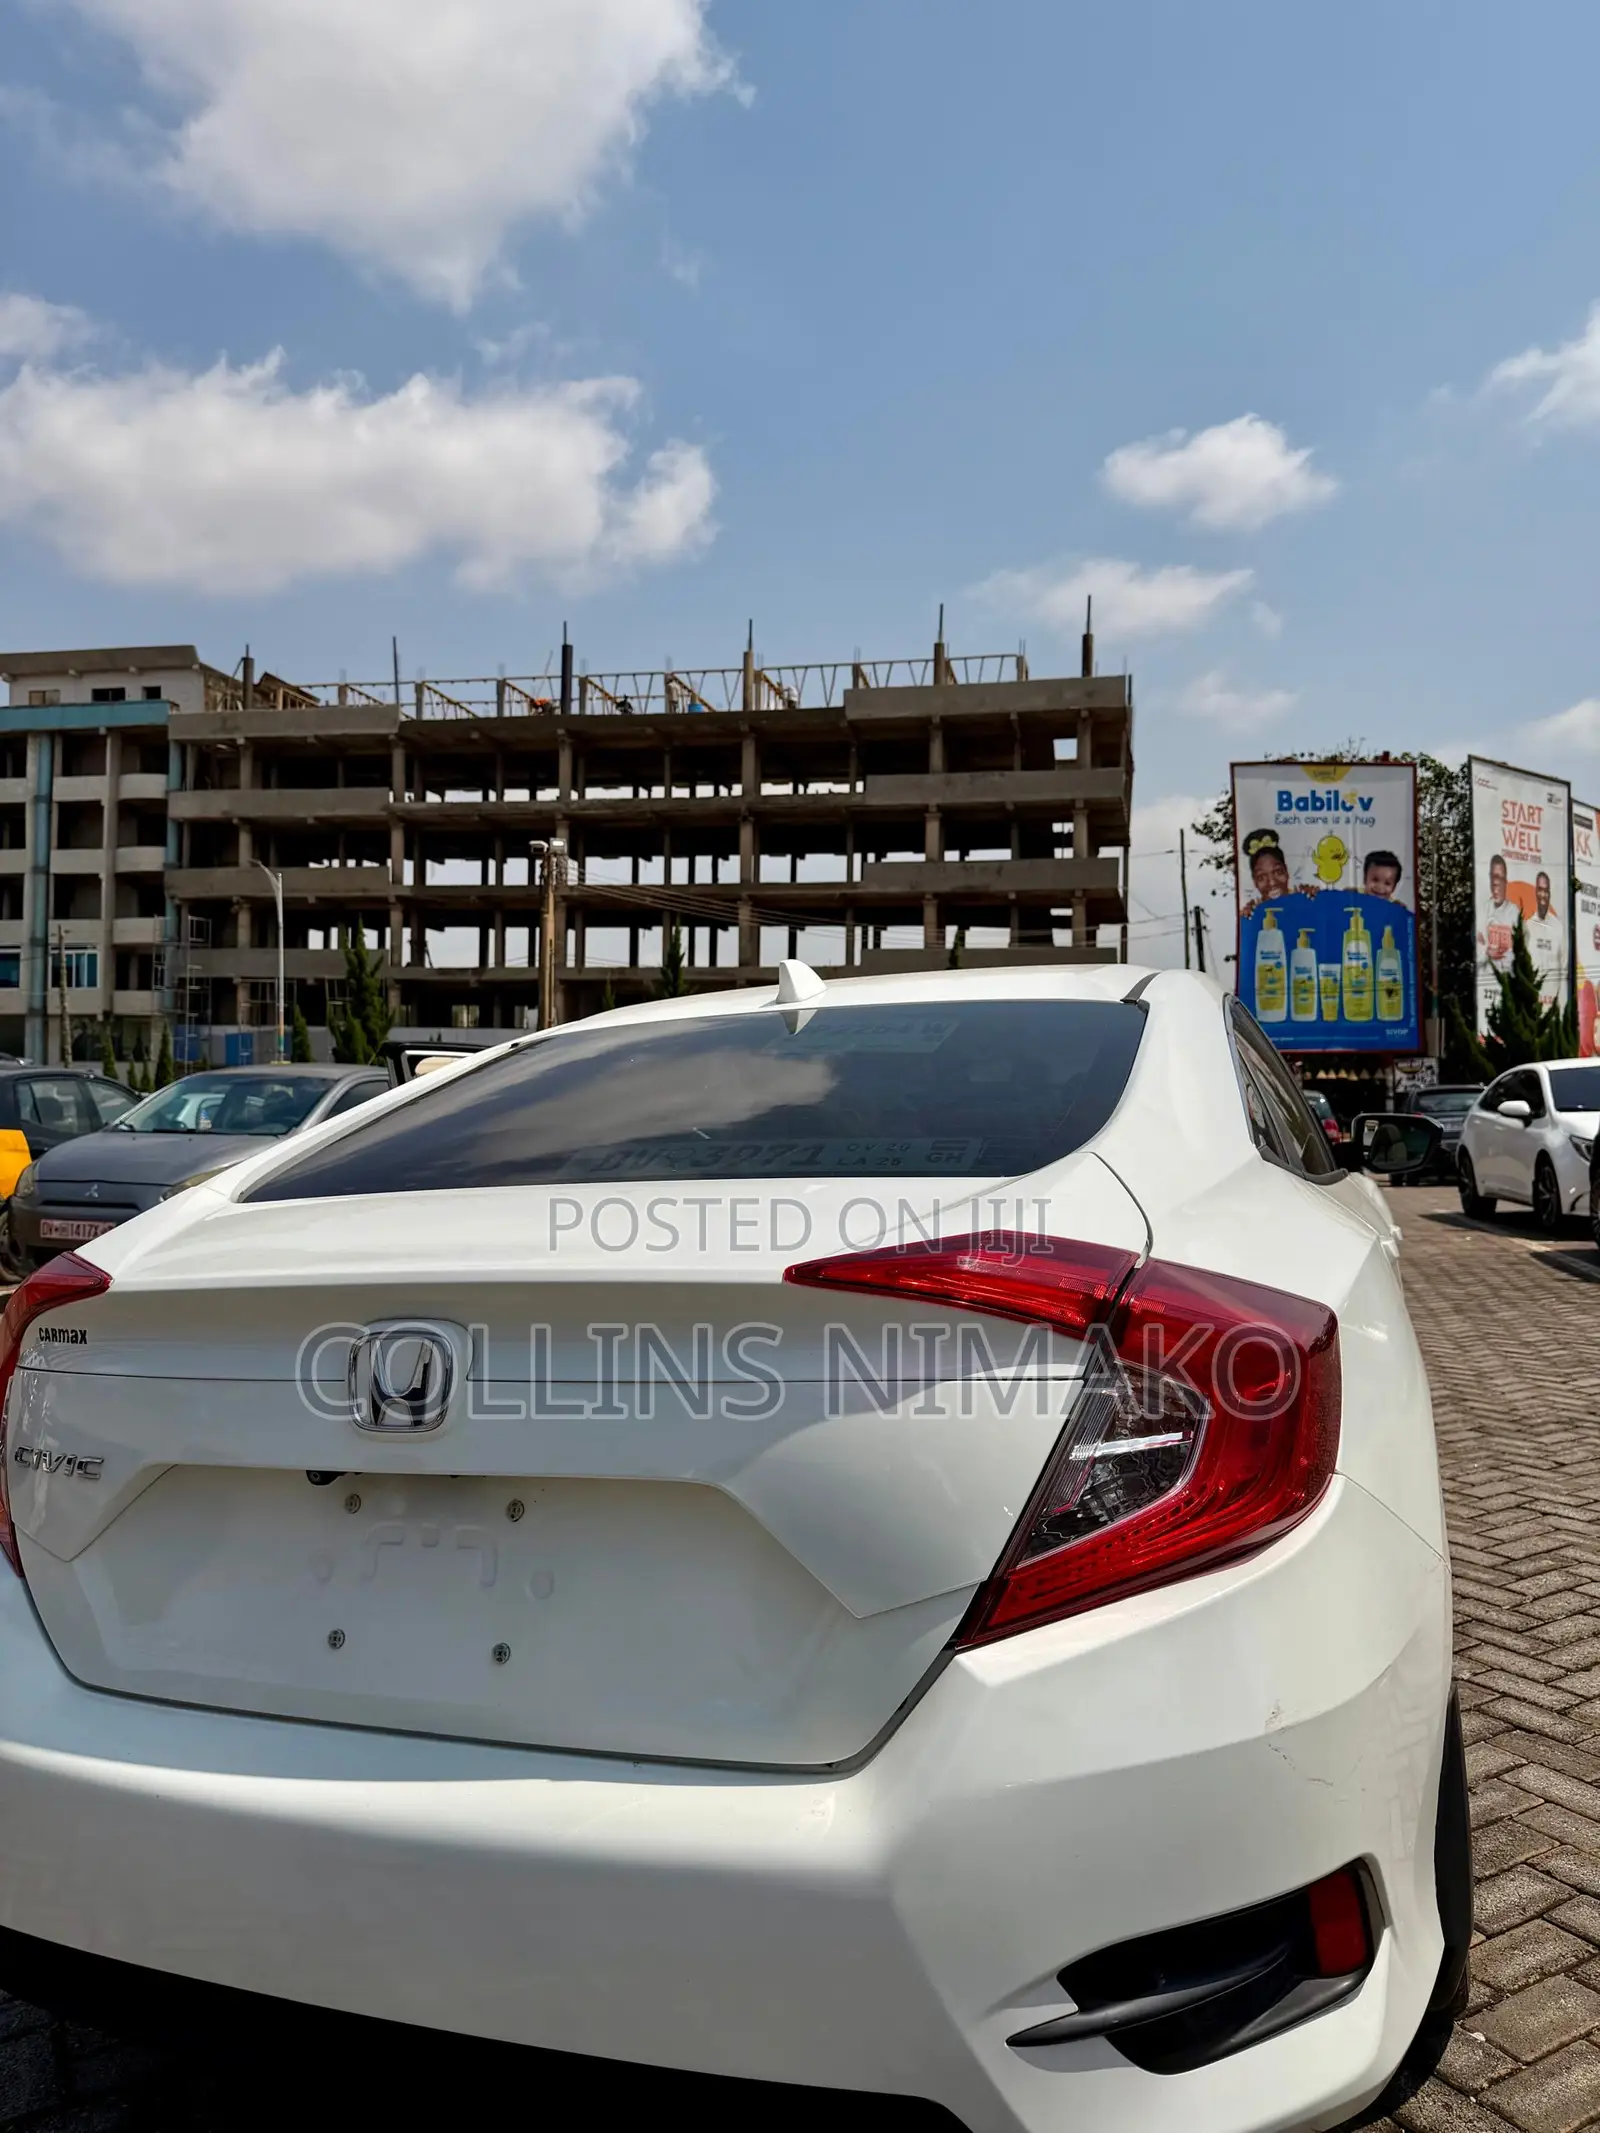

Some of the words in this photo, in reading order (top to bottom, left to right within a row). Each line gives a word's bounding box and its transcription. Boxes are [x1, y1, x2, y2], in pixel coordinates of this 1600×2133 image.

[1274, 813, 1301, 825] Each
[1304, 816, 1328, 825] care
[1332, 814, 1340, 825] is
[1344, 816, 1351, 825] a
[1354, 813, 1376, 828] hug
[1501, 799, 1544, 825] START
[1501, 825, 1542, 853] WELL
[925, 1152, 965, 1163] GH
[14, 1445, 104, 1480] CIVIC
